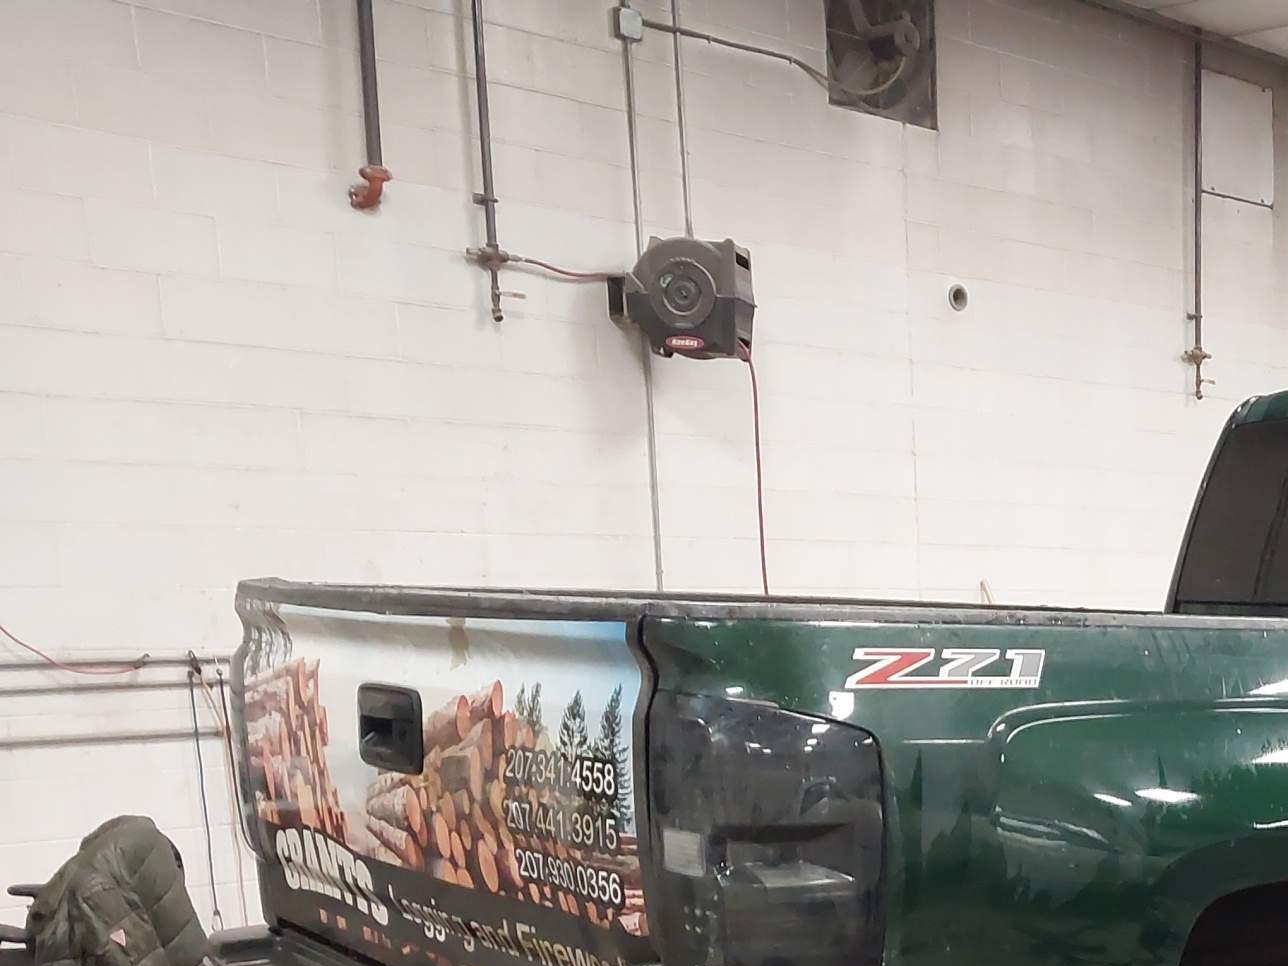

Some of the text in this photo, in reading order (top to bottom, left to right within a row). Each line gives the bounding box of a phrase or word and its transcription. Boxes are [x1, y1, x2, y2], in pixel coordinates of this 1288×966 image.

[844, 647, 1045, 688] Z71
[505, 749, 616, 796] 207.341.4558
[503, 799, 617, 850] 207.441.3915
[276, 828, 389, 926] GRANTS
[470, 919, 520, 957] and
[515, 848, 622, 904] 207.930.0356
